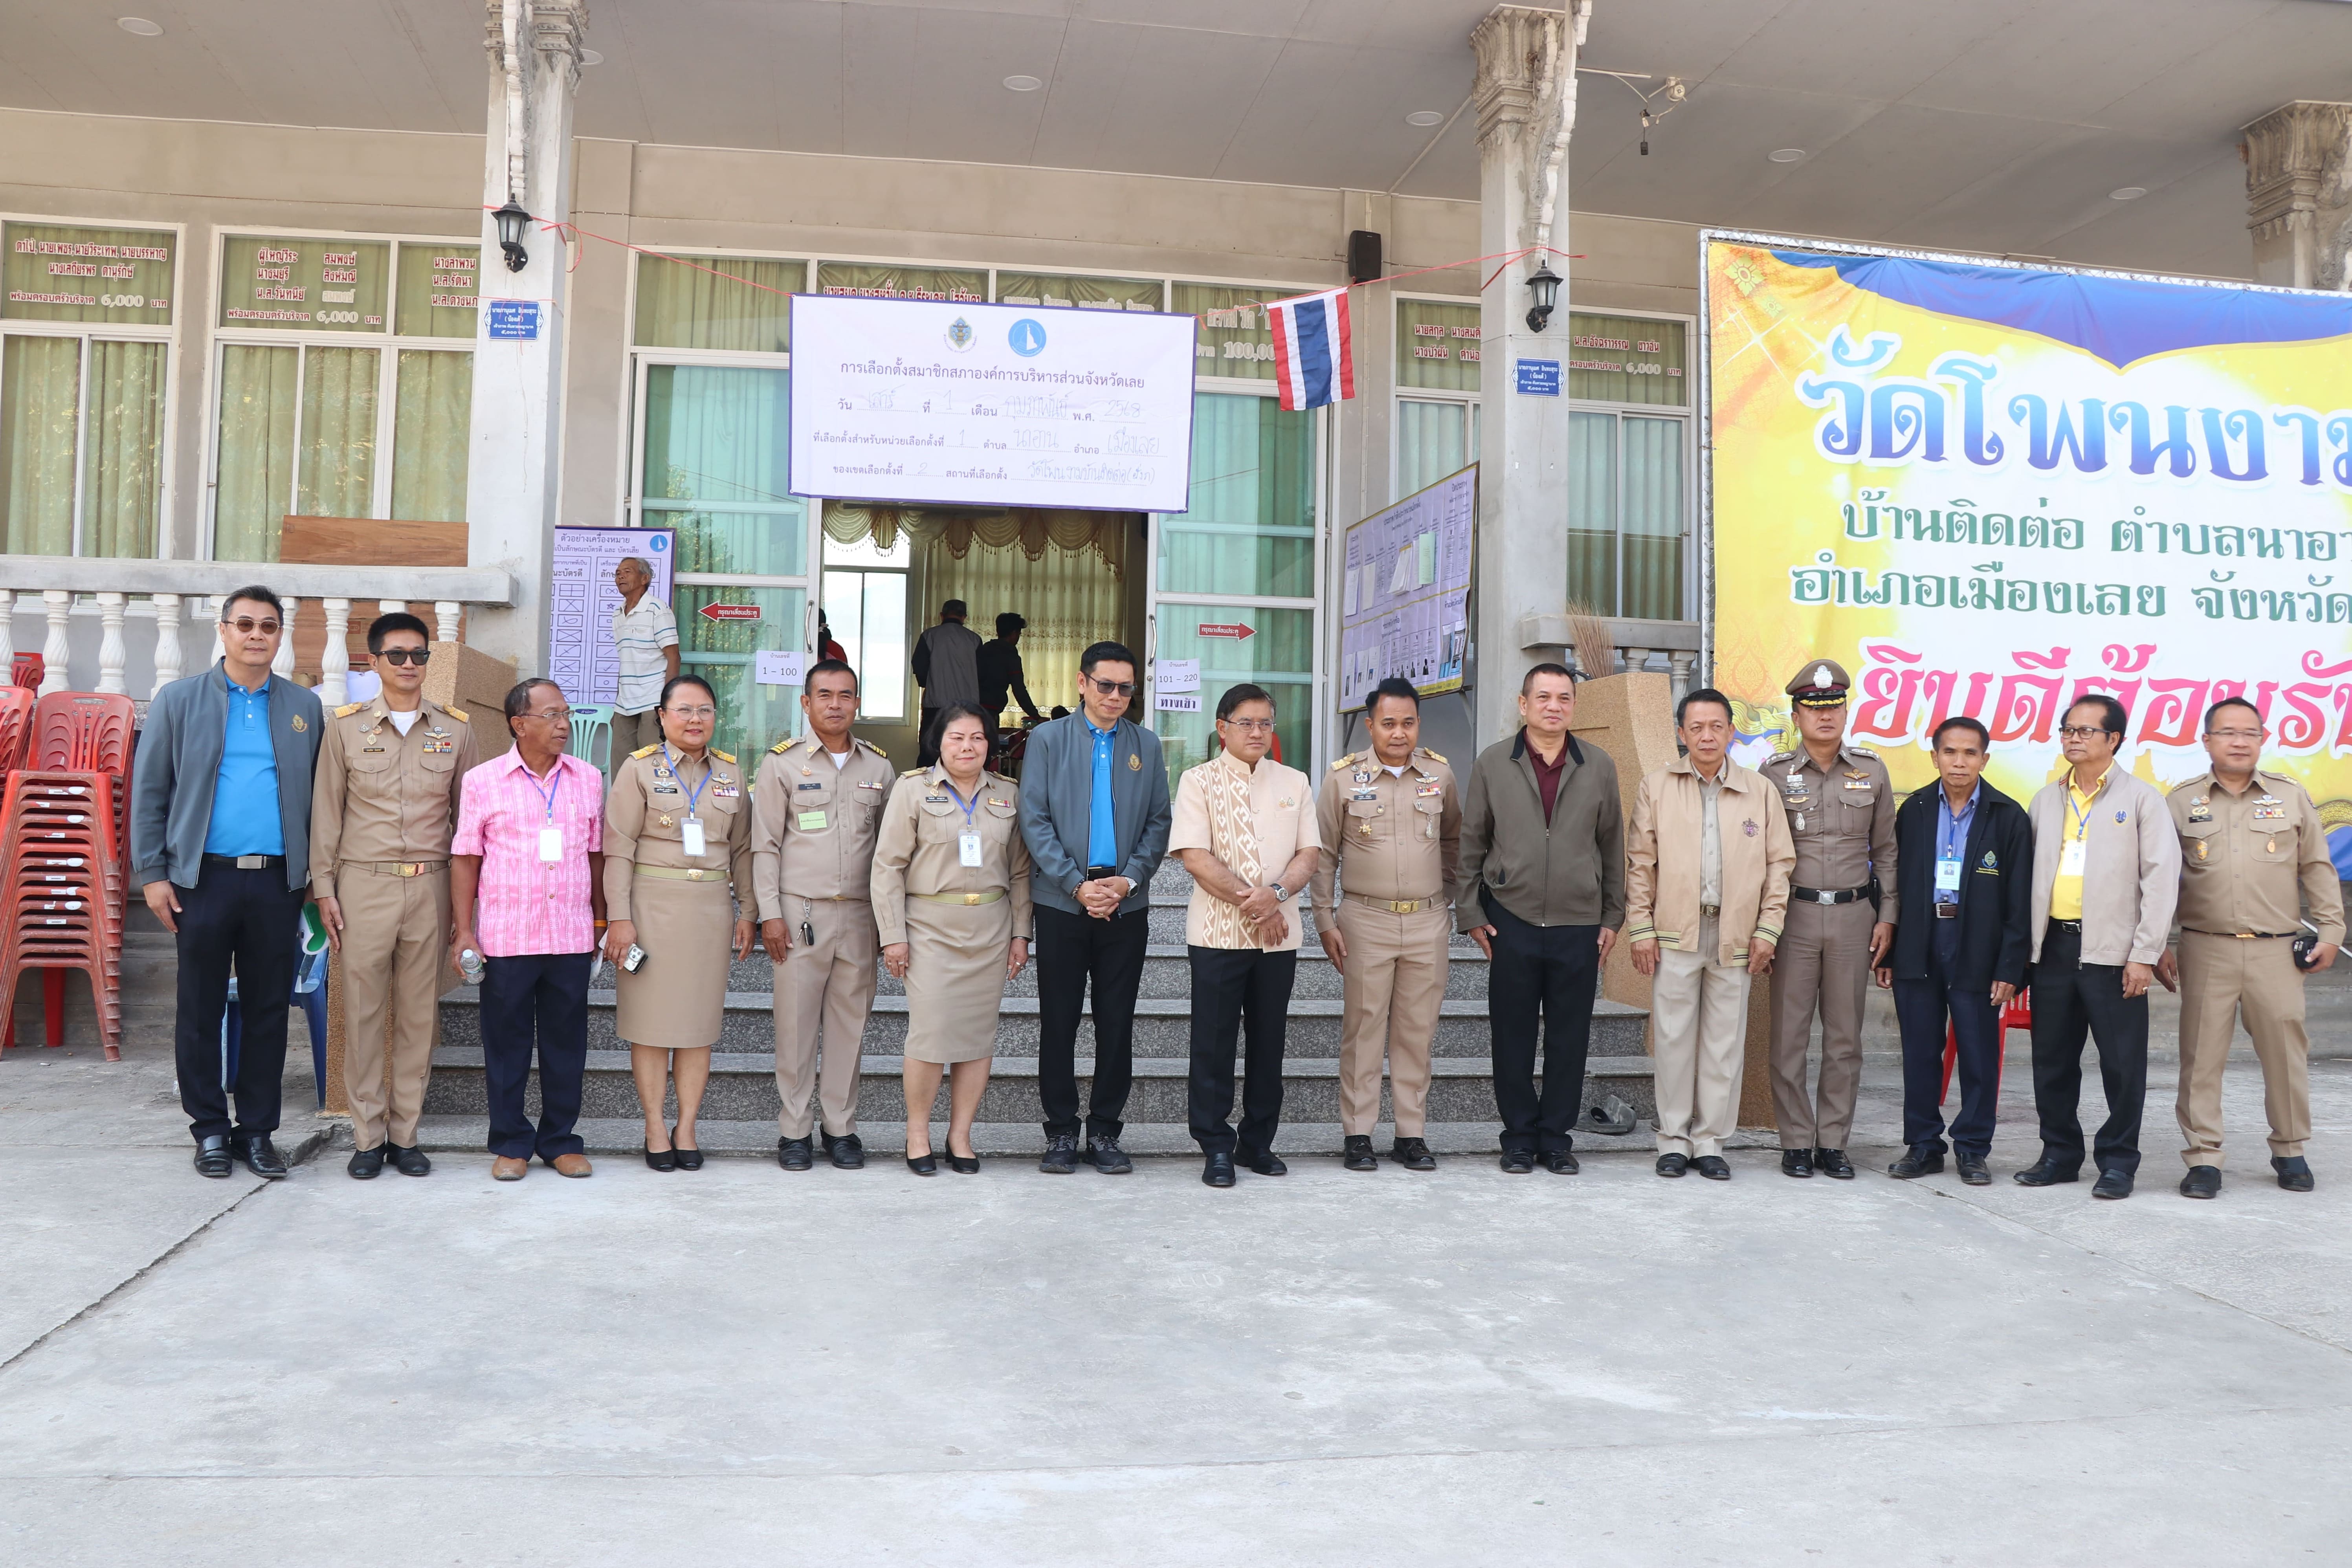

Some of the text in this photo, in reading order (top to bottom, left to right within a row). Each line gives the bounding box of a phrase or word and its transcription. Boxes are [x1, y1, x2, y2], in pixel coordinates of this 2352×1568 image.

[257, 266, 289, 284] นางมยุรี
[10, 290, 167, 308] พร้อมครอบครัวบริจาค 6,000 บาท
[227, 308, 382, 324] พร้อมครอบครัวบริจาค 6,000 บาท
[841, 357, 1145, 388] การเลือกตั้งสมาชิกสภาองค์การบริหารส่วนจังหวัดเลย
[1626, 362, 1661, 374] 6,000
[1667, 367, 1681, 376] บาท
[838, 397, 852, 410] วัน
[868, 383, 905, 409] เสาร์
[944, 390, 953, 410] 1
[971, 404, 998, 417] เดือน
[1005, 391, 1073, 421] กุมภาพันธ์
[1072, 411, 1095, 422] พ.ศ.
[1104, 399, 1141, 418] 2568
[813, 430, 945, 447] ที่เลือกตั้งสำหรับหน่วยเลือกตั้งที่
[959, 429, 965, 446] 1
[983, 440, 1007, 450] ตำบล
[1074, 444, 1099, 455] อำเภอ
[1107, 426, 1160, 455] เมืองเลย
[833, 462, 903, 475] ของเขตเลือกตั้งที่
[917, 462, 928, 474] 2
[946, 466, 1007, 480] สถานที่เลือกตั้ง
[1843, 490, 2084, 550] บ้านติดต่อ
[561, 532, 630, 543] ตัวอย่างเครื่องหมาย
[554, 544, 602, 552] เป็นลักษณะบัตรดี
[1792, 552, 2352, 624] อำเภอเมืองเลย จังหวัด
[1184, 673, 1198, 682] 220
[1160, 697, 1196, 709] ทางเข้า
